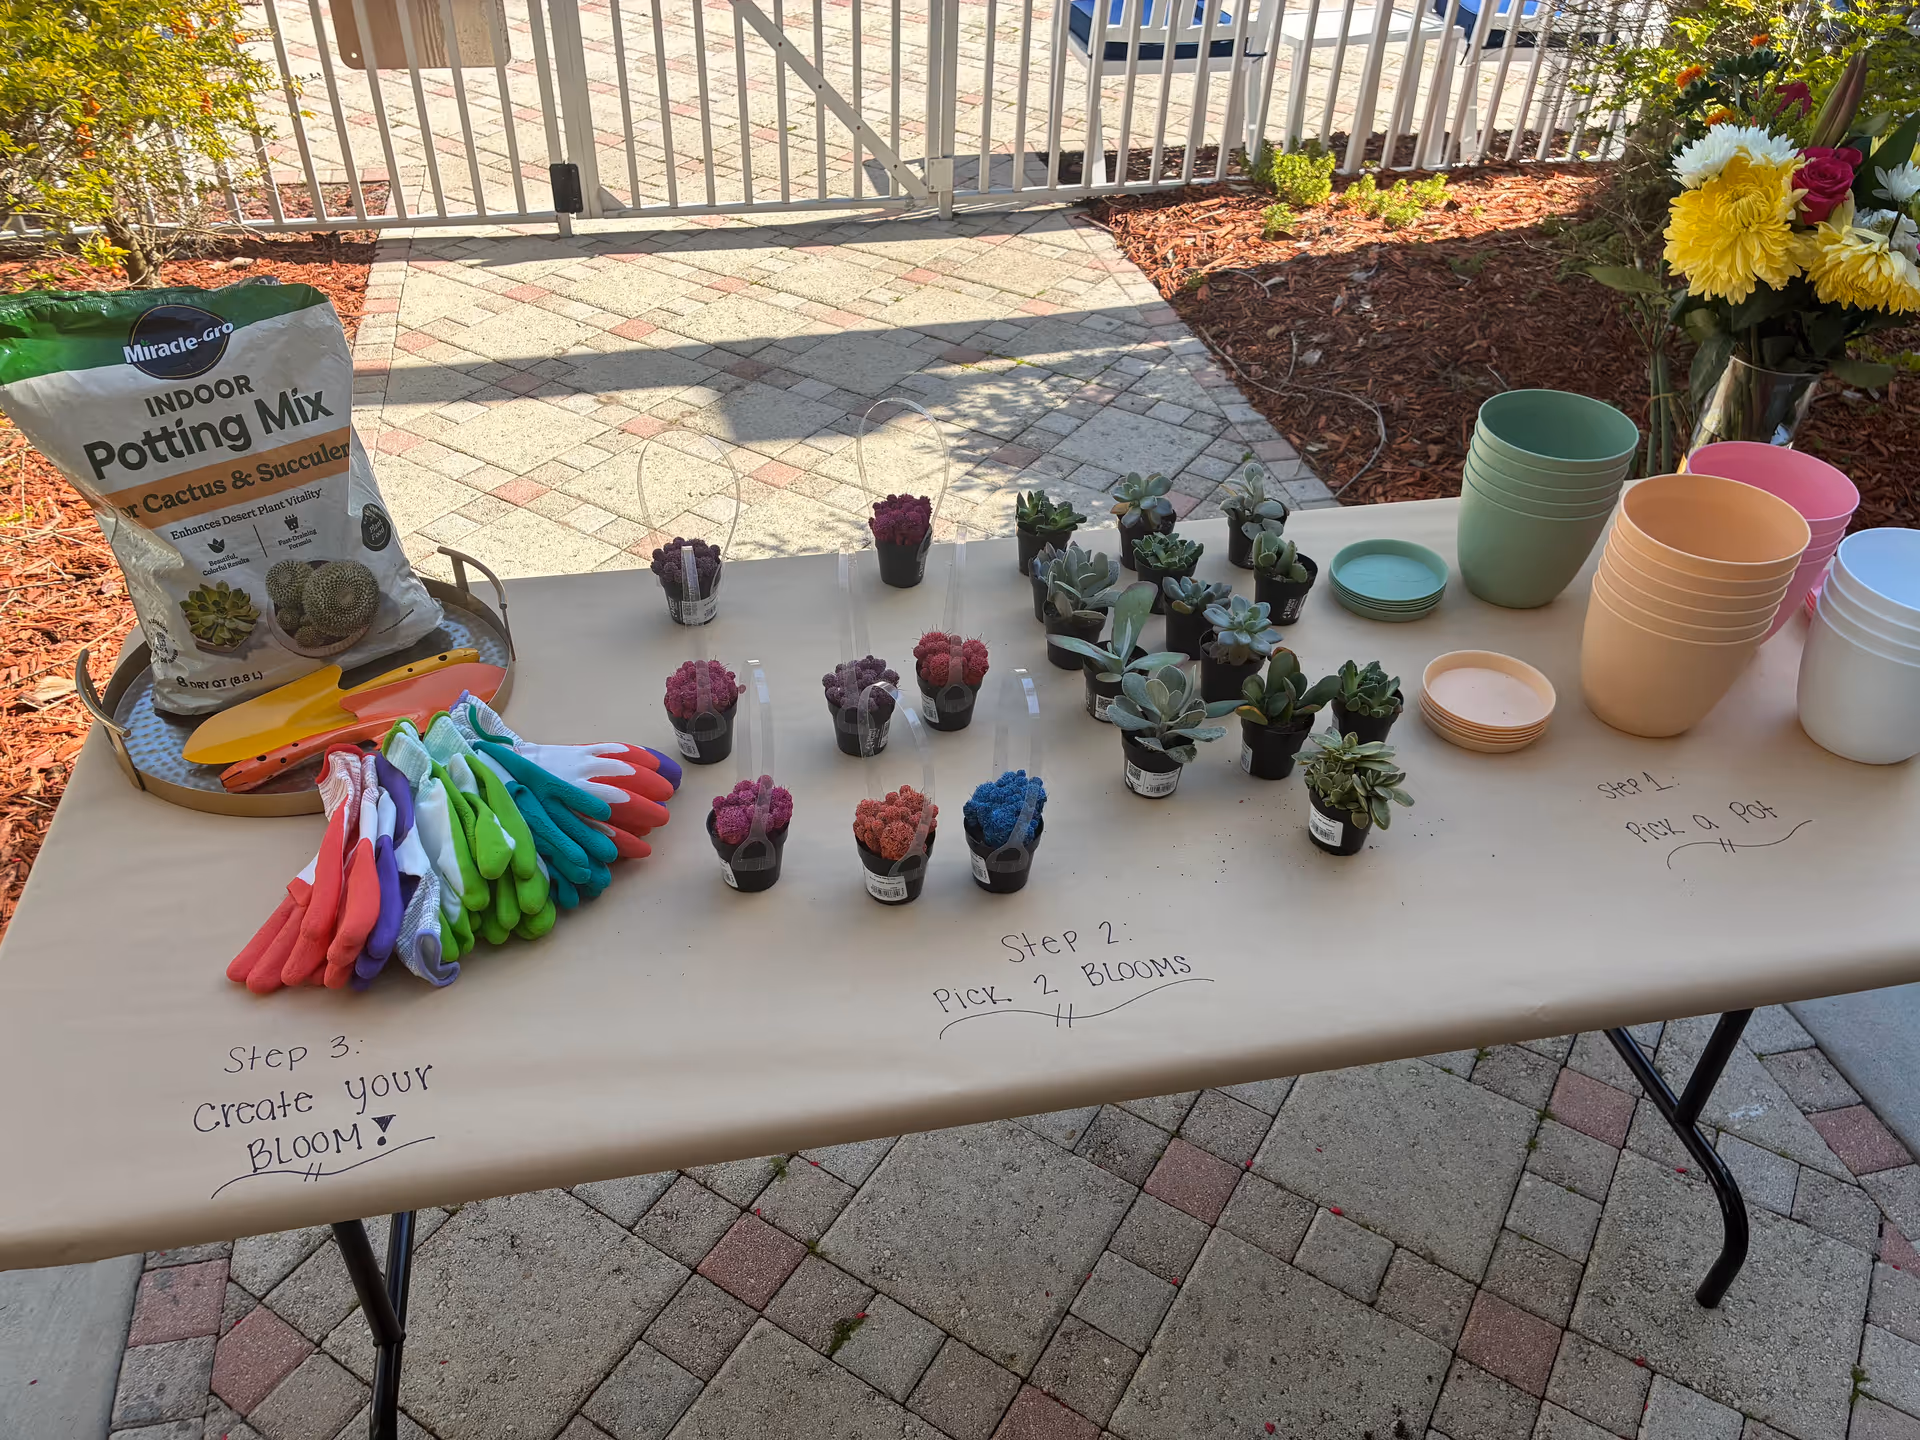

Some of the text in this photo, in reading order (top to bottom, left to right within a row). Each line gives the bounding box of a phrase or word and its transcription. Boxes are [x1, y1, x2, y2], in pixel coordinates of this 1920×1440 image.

[122, 321, 234, 364] Miracle-Gro
[143, 375, 255, 417] INDOOR
[83, 387, 334, 480] Potting Mix
[143, 478, 228, 513] Cactus
[231, 470, 255, 489] &
[170, 519, 222, 540] Enhances
[222, 508, 257, 526] Desert
[257, 500, 285, 516] Plant
[278, 529, 317, 546] Fast-Draining
[288, 538, 312, 550] Formula
[202, 557, 250, 576] Colorful Results
[189, 680, 210, 690] DRY
[212, 678, 227, 688] QT
[230, 673, 250, 687] (8.8
[251, 671, 263, 681] L)
[1692, 814, 1719, 830] a
[1098, 921, 1132, 945] 2:
[1033, 974, 1058, 994] 2
[1081, 955, 1192, 986] BLOOMS
[330, 1035, 363, 1058] 3:
[193, 1064, 433, 1132] Create your
